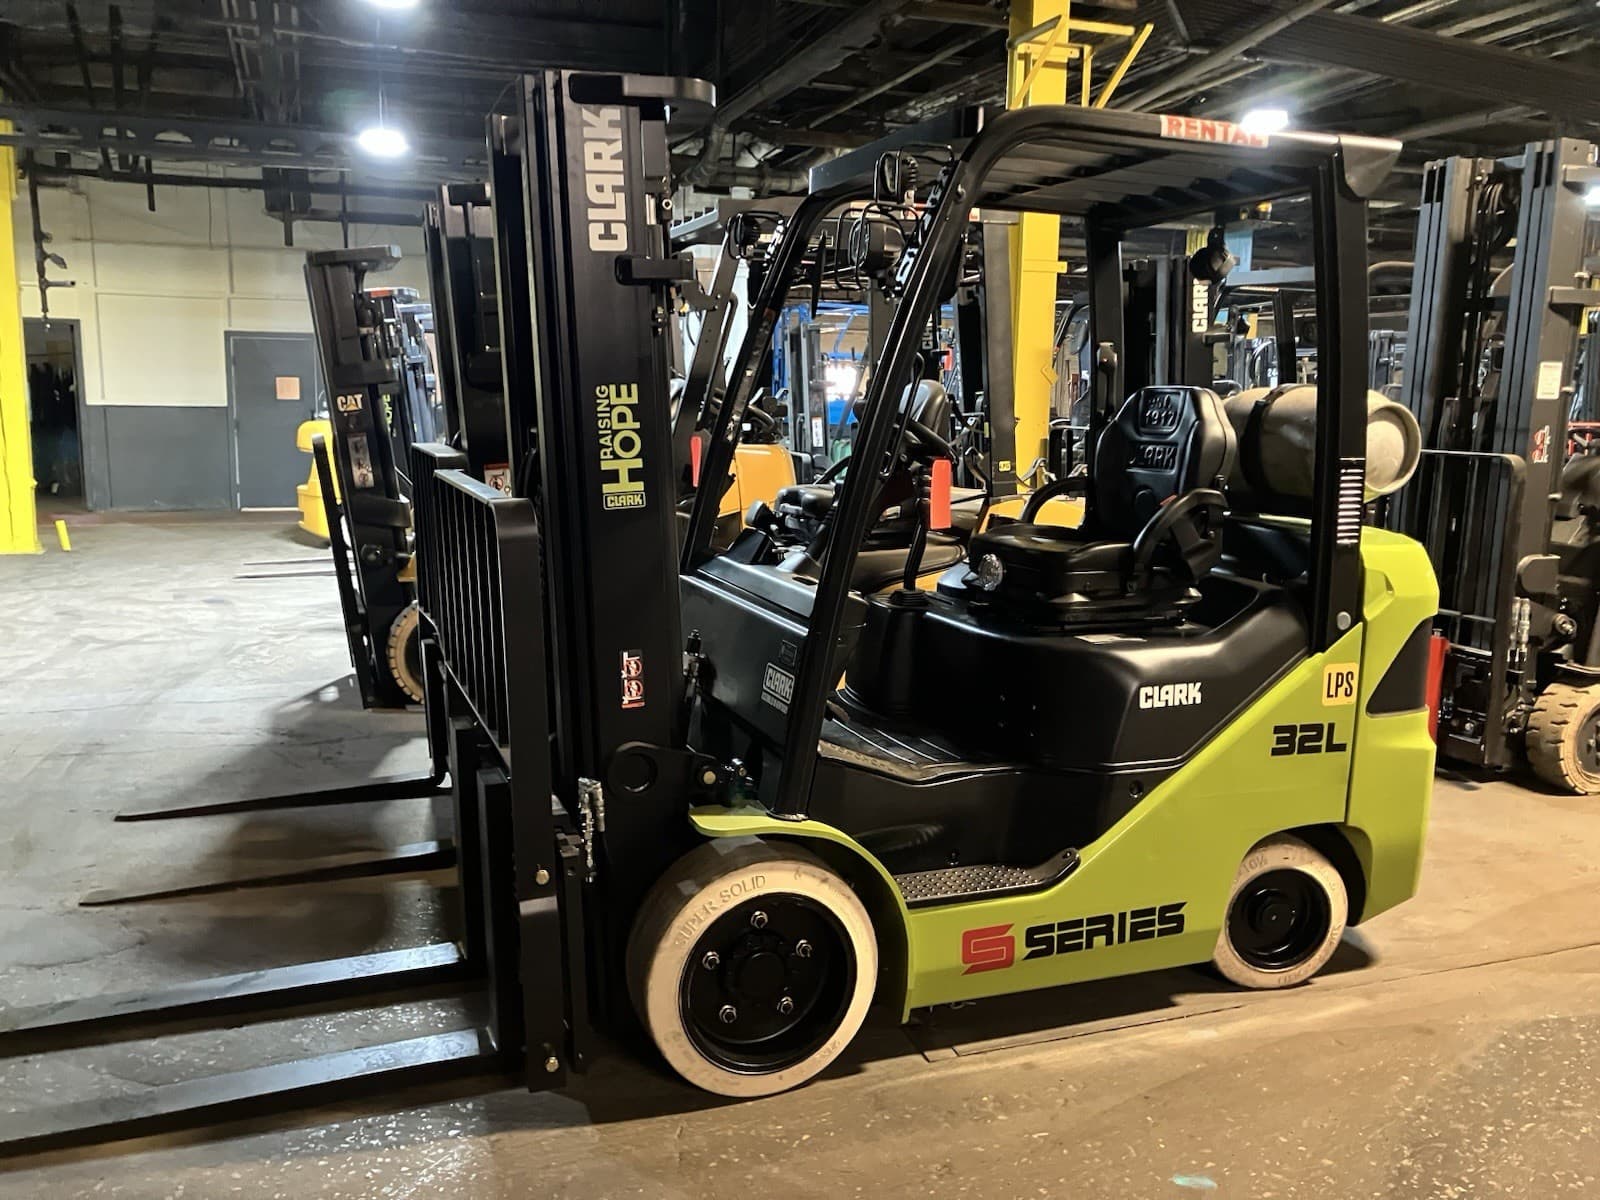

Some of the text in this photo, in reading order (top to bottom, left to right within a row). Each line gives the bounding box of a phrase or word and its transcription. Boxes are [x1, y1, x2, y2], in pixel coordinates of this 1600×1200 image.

[582, 107, 628, 251] CLARK
[337, 394, 363, 412] CAT
[596, 384, 614, 459] RAISING
[600, 383, 645, 493] HOPE
[1129, 443, 1176, 468] ARK
[606, 494, 643, 507] CLARK
[765, 666, 794, 701] CLARK
[1139, 682, 1202, 709] CLARK
[1326, 670, 1355, 699] LPS
[1270, 722, 1348, 757] 32L
[676, 875, 766, 945] SUPER SOLID
[1022, 902, 1188, 961] SERIES
